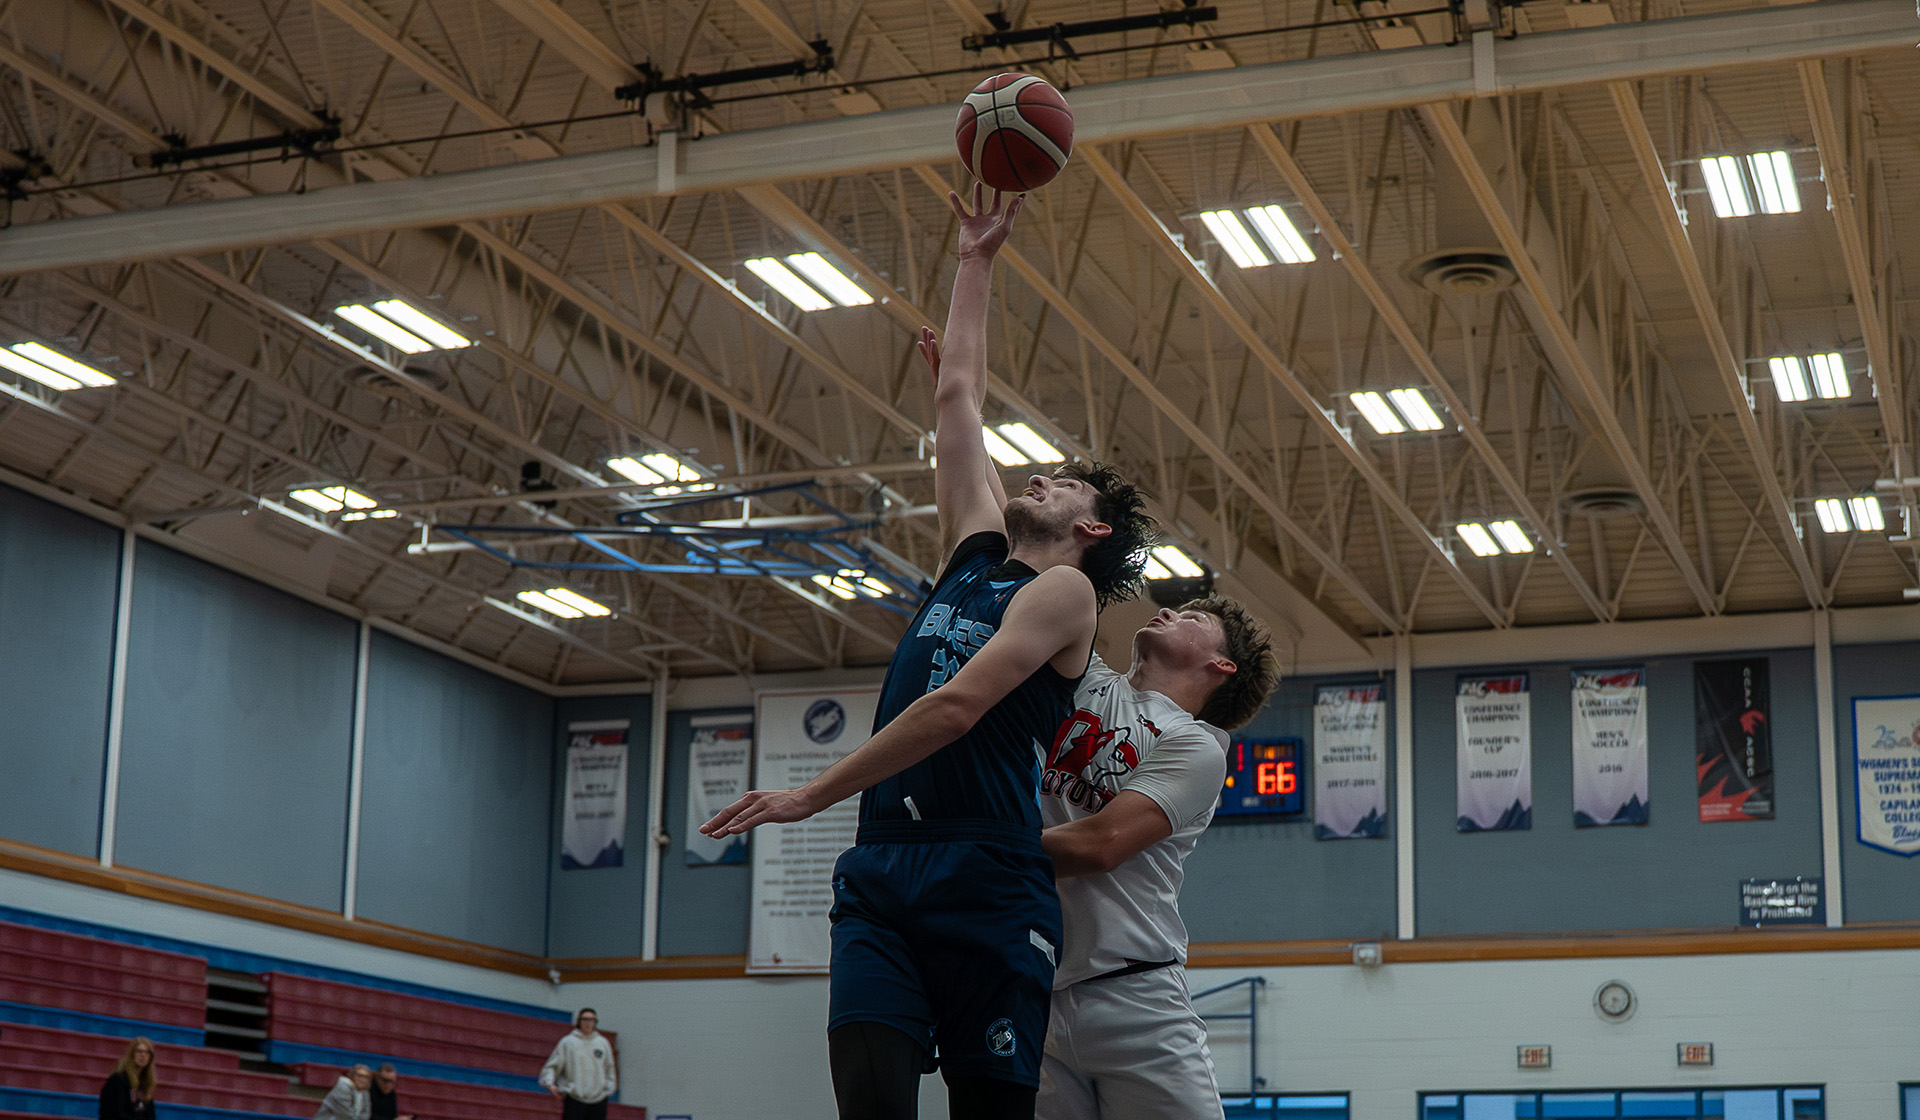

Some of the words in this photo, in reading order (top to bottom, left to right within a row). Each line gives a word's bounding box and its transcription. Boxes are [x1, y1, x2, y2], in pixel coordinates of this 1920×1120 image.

[926, 648, 961, 694] 2
[1859, 757, 1908, 769] WOMEN'S
[1257, 762, 1297, 794] 66
[1040, 768, 1107, 813] OYOT
[1786, 885, 1799, 895] on
[1801, 882, 1818, 894] the
[1798, 895, 1818, 906] Rim
[1524, 1048, 1545, 1064] EXIT
[1685, 1045, 1706, 1061] EXIT
